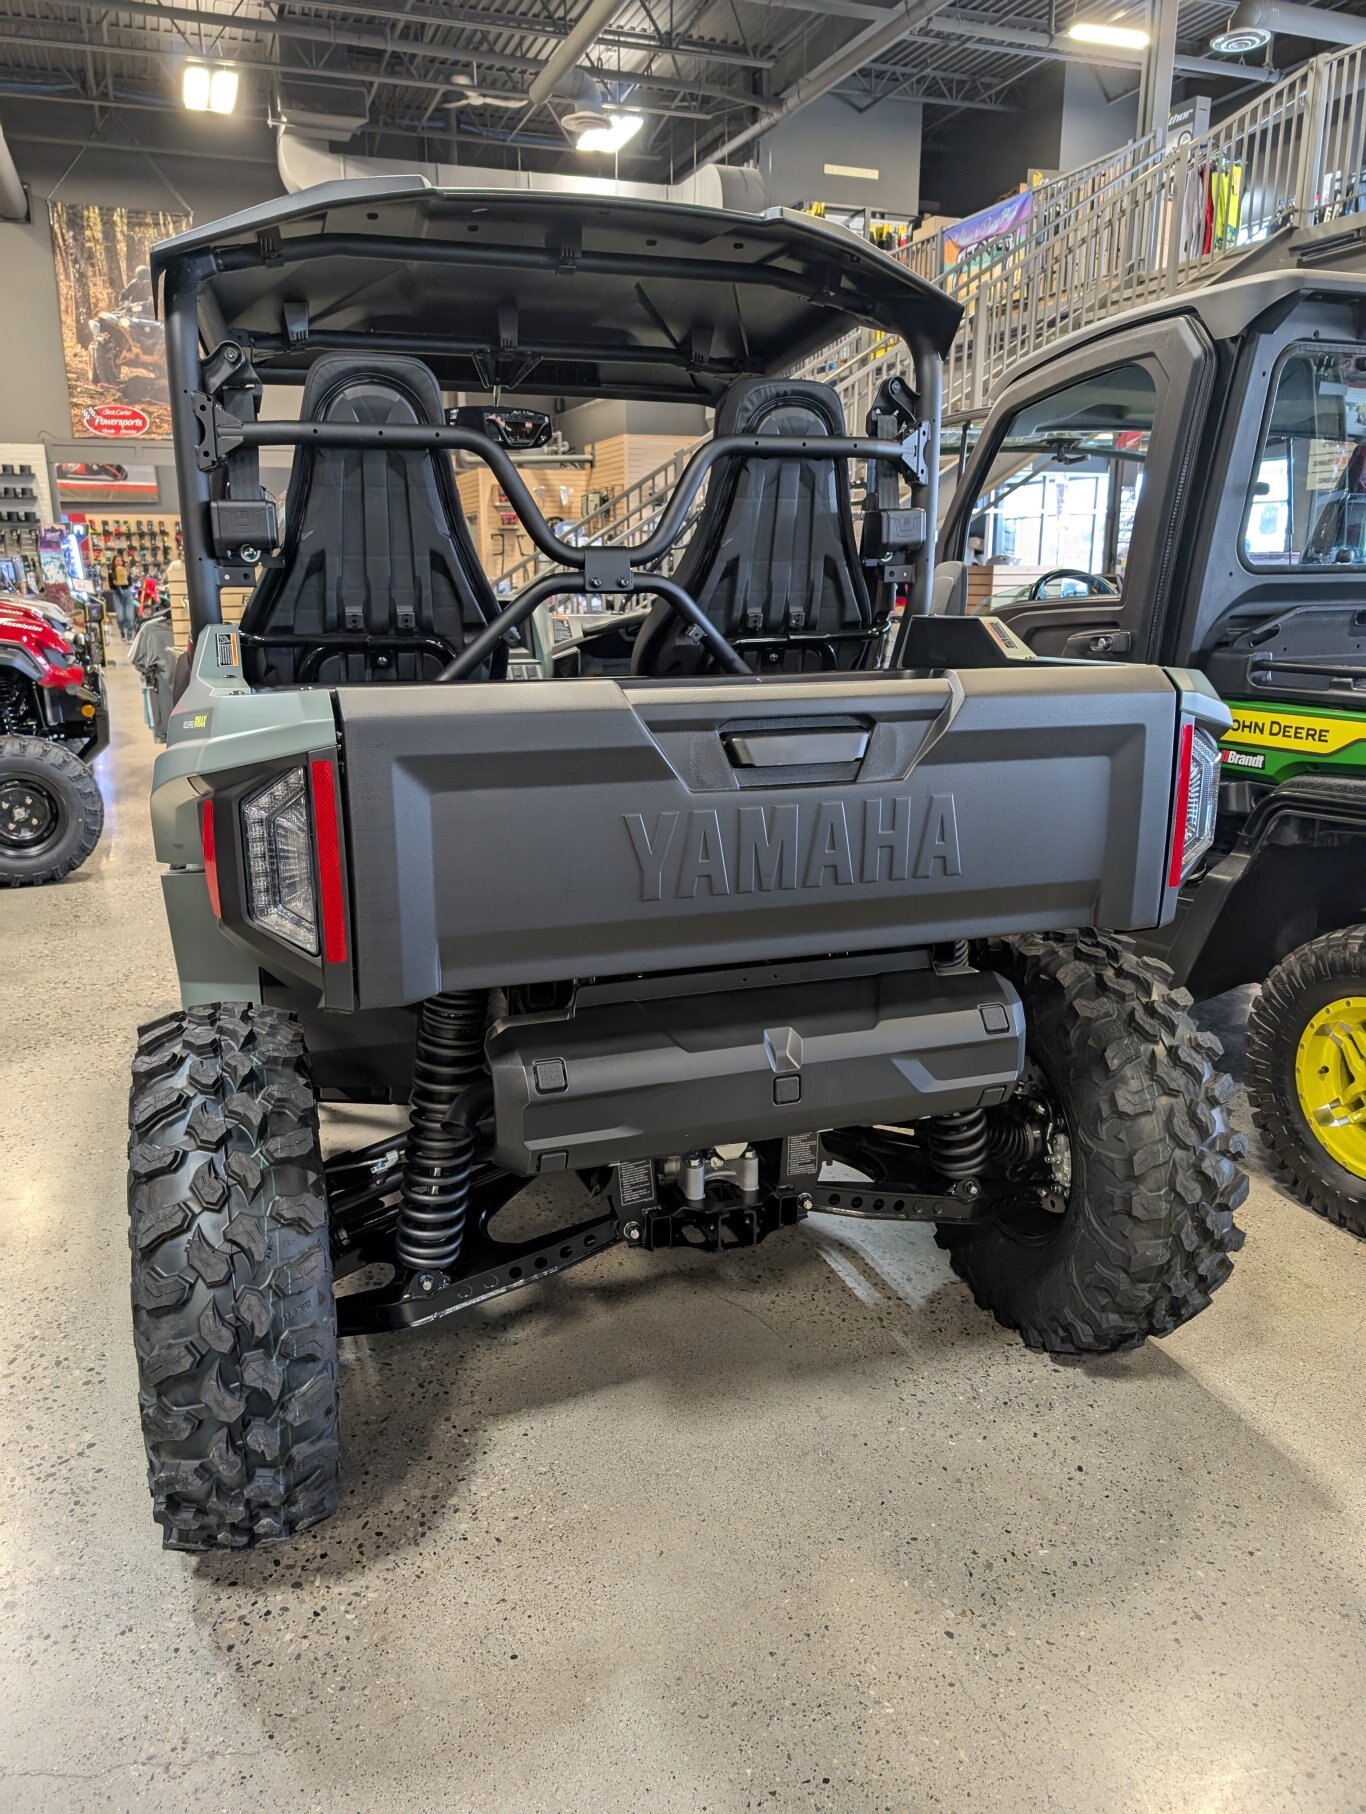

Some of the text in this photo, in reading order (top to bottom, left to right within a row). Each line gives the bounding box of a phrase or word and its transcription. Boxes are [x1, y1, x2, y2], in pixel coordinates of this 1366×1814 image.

[94, 415, 143, 428] Powersports
[1231, 719, 1330, 743] OHN DEERE
[1228, 750, 1265, 769] Brandt
[622, 793, 962, 902] YAMAHA
